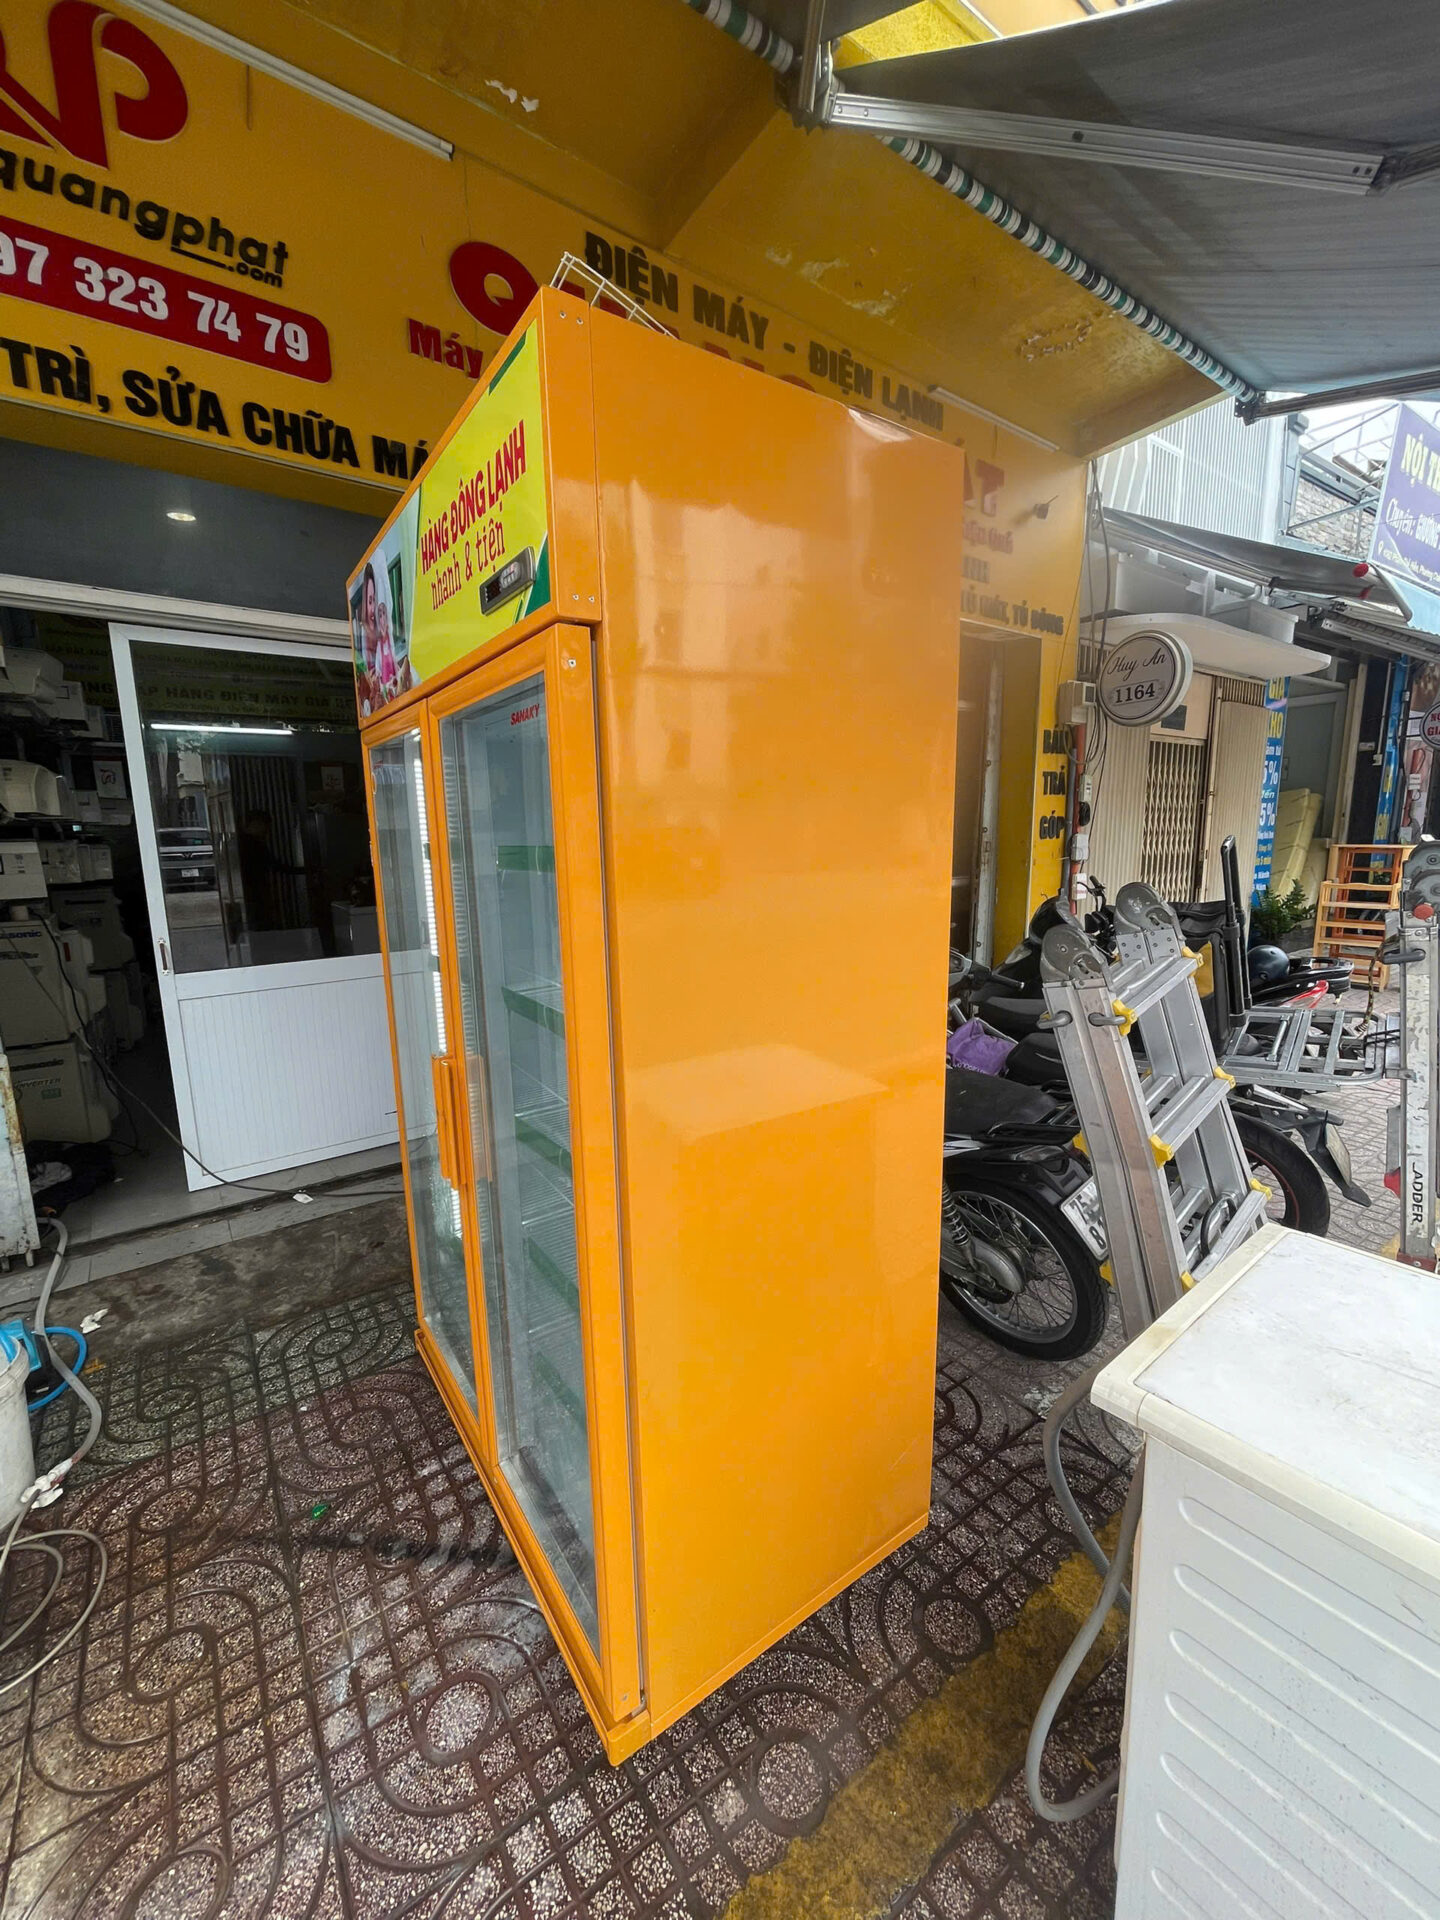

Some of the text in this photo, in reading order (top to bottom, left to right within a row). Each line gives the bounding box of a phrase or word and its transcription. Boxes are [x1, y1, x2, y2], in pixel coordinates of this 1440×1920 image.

[73, 256, 169, 320] 323
[187, 290, 242, 342] 74
[255, 312, 309, 362] 79
[585, 231, 678, 312] ĐIỆN
[693, 284, 769, 350] MÁY
[808, 340, 873, 399] ĐIỆN
[882, 376, 944, 431] LẠNH
[408, 318, 484, 378] Máy
[122, 366, 230, 437] SỬA
[242, 402, 360, 468] CHỮA
[420, 419, 526, 575] HÀNG ĐÔNG LẠNH
[431, 552, 461, 611] nhanh
[464, 540, 472, 581] &
[1107, 647, 1166, 681] Huy An
[1115, 683, 1155, 703] 1164
[510, 703, 540, 726] SANAKY
[1040, 810, 1065, 840] GÓP
